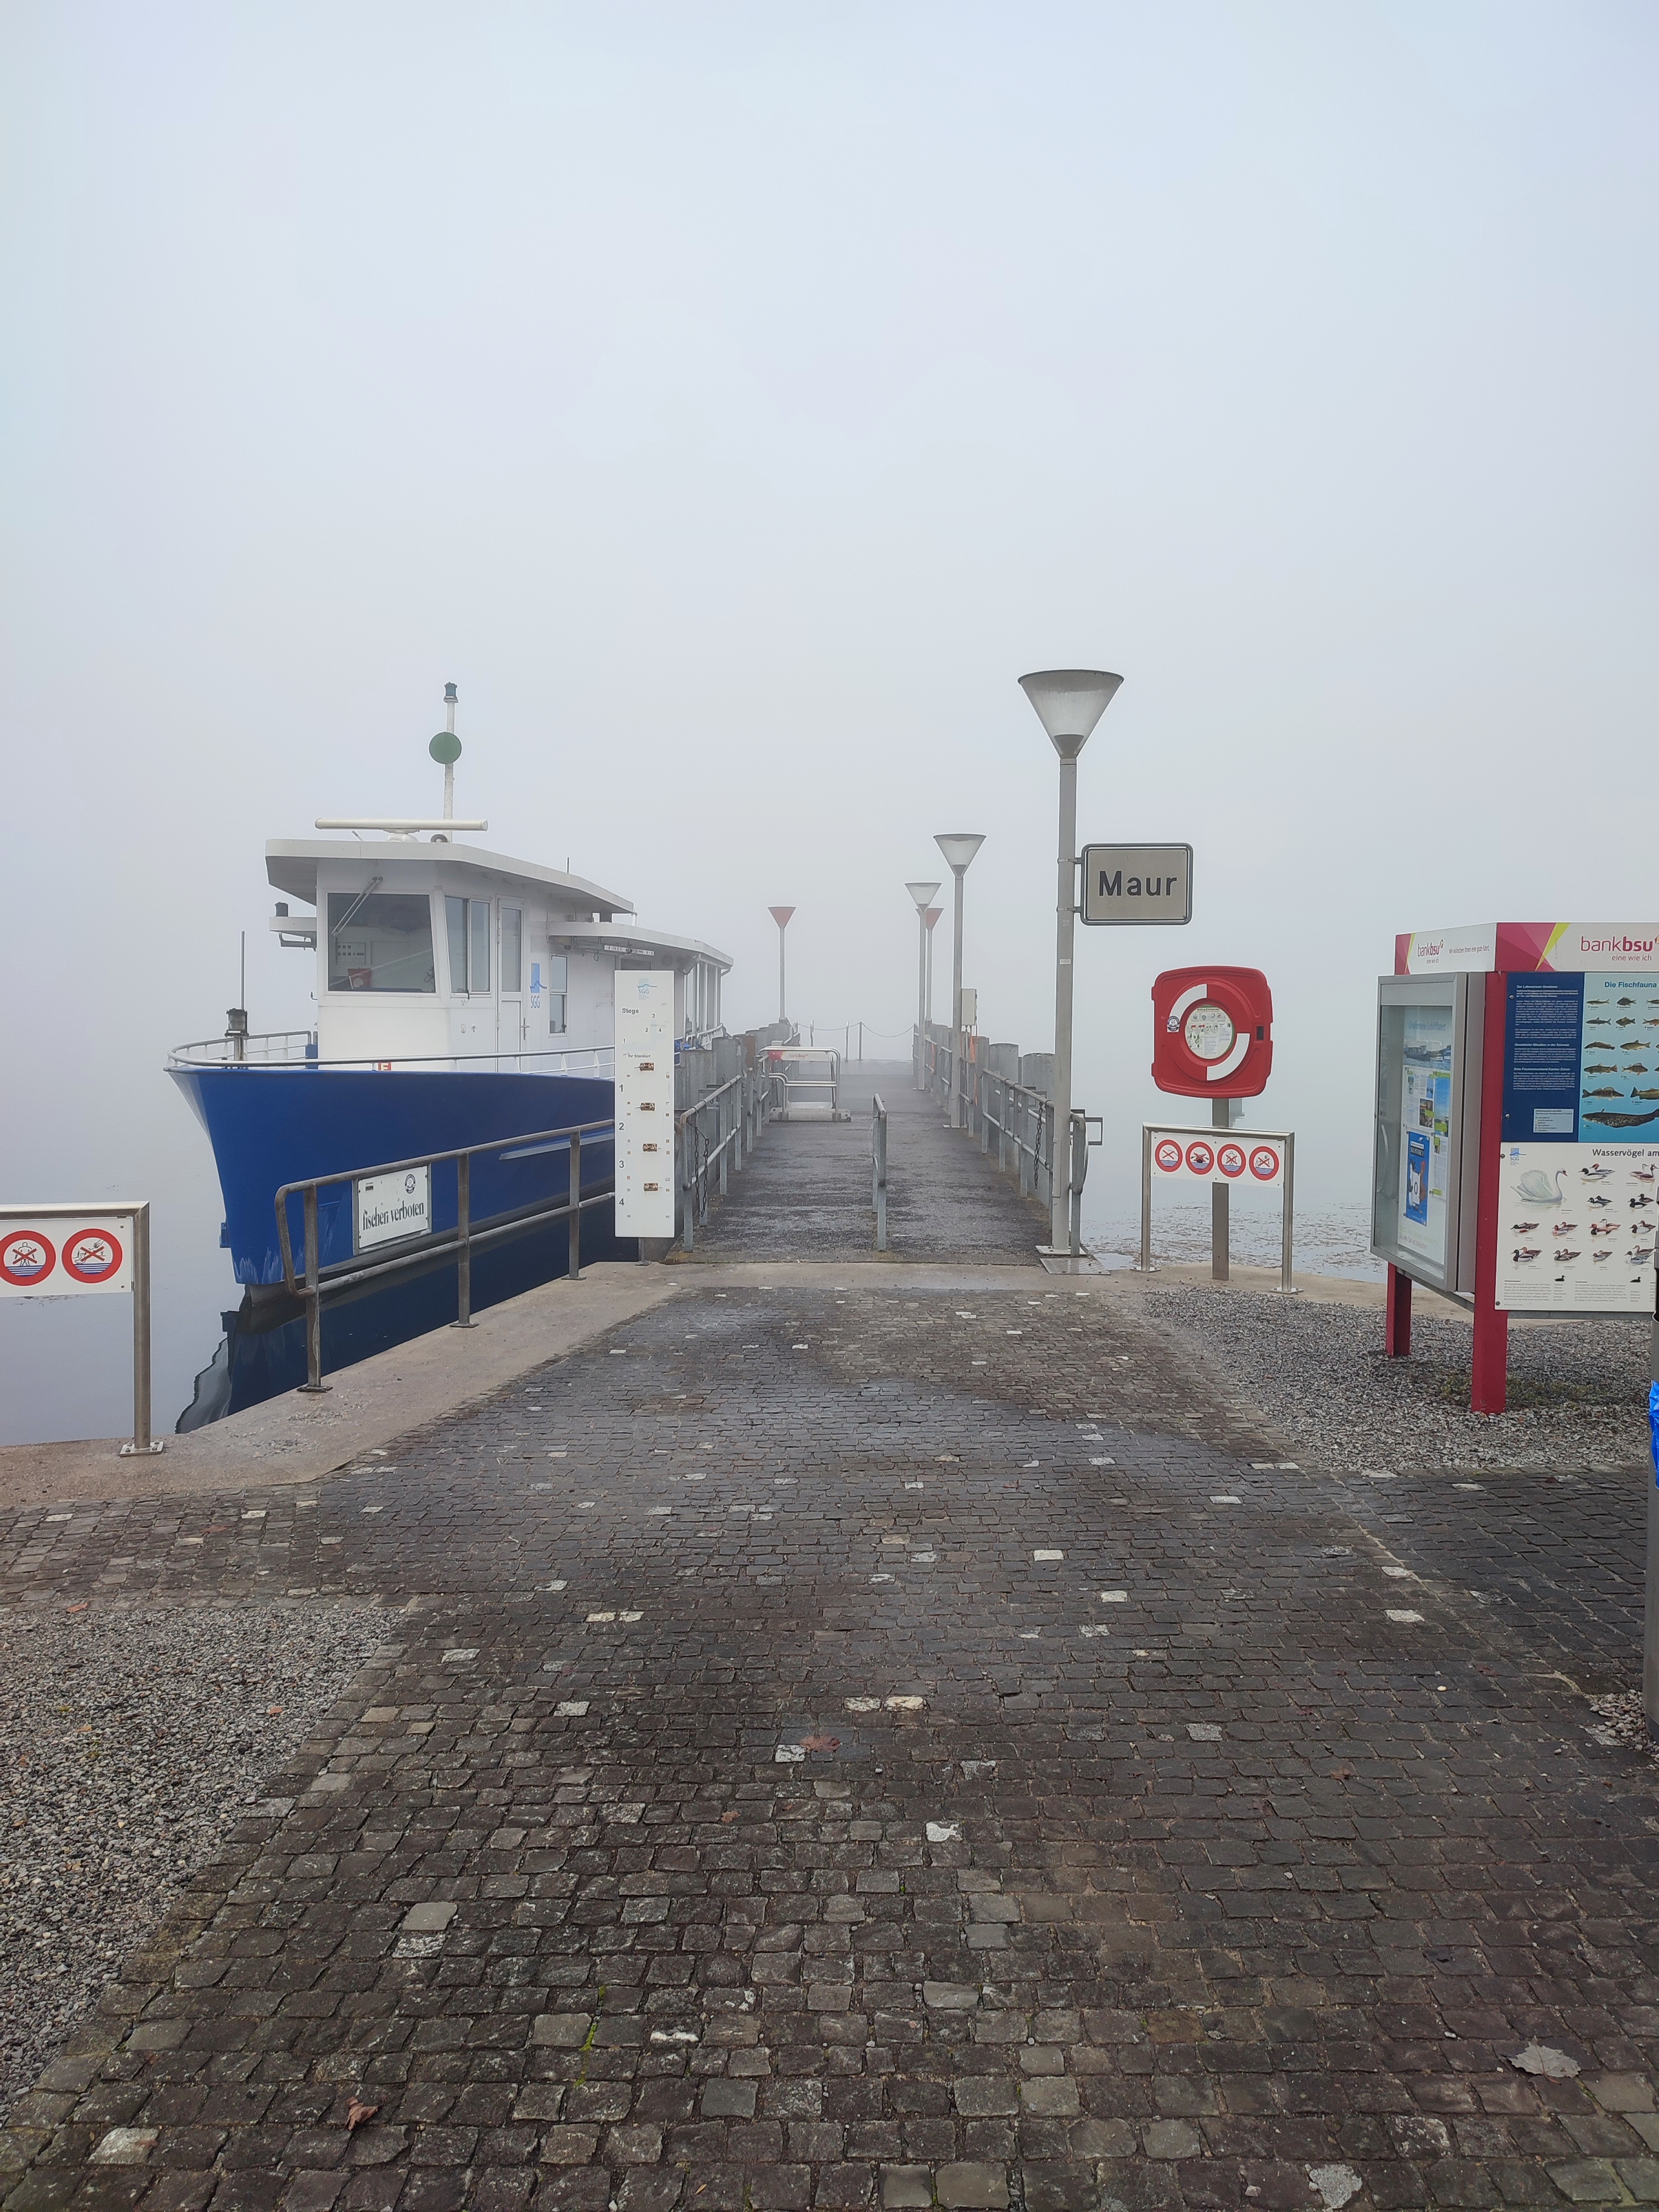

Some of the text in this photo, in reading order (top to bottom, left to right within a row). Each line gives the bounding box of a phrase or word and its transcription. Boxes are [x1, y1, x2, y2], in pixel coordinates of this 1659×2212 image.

[1099, 870, 1177, 896] Maur
[1417, 942, 1440, 957] bankbsu
[1581, 936, 1653, 952] bankbsu
[530, 995, 540, 1009] SGG
[618, 1084, 623, 1093] 1
[618, 1122, 624, 1131] 2
[1593, 1149, 1644, 1159] Wasservögel
[618, 1160, 624, 1168] 3
[618, 1198, 625, 1206] 4
[363, 1199, 424, 1230] fischen verboten
